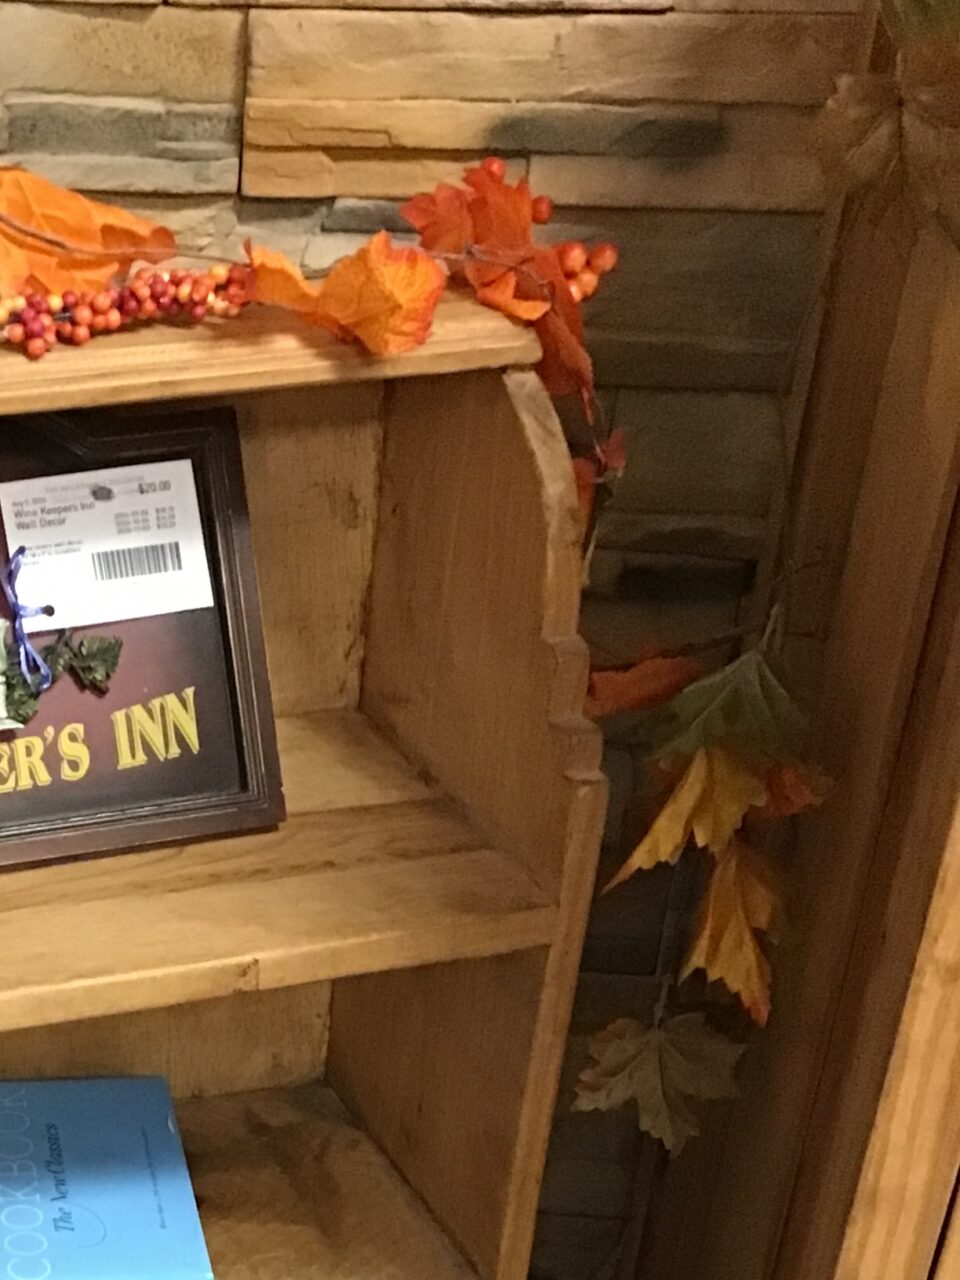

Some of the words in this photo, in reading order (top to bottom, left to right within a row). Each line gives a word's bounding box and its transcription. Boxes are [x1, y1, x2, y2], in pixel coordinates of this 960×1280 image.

[110, 686, 201, 771] INN
[45, 1121, 66, 1175] Classics
[49, 1176, 70, 1203] New
[50, 1206, 75, 1233] The
